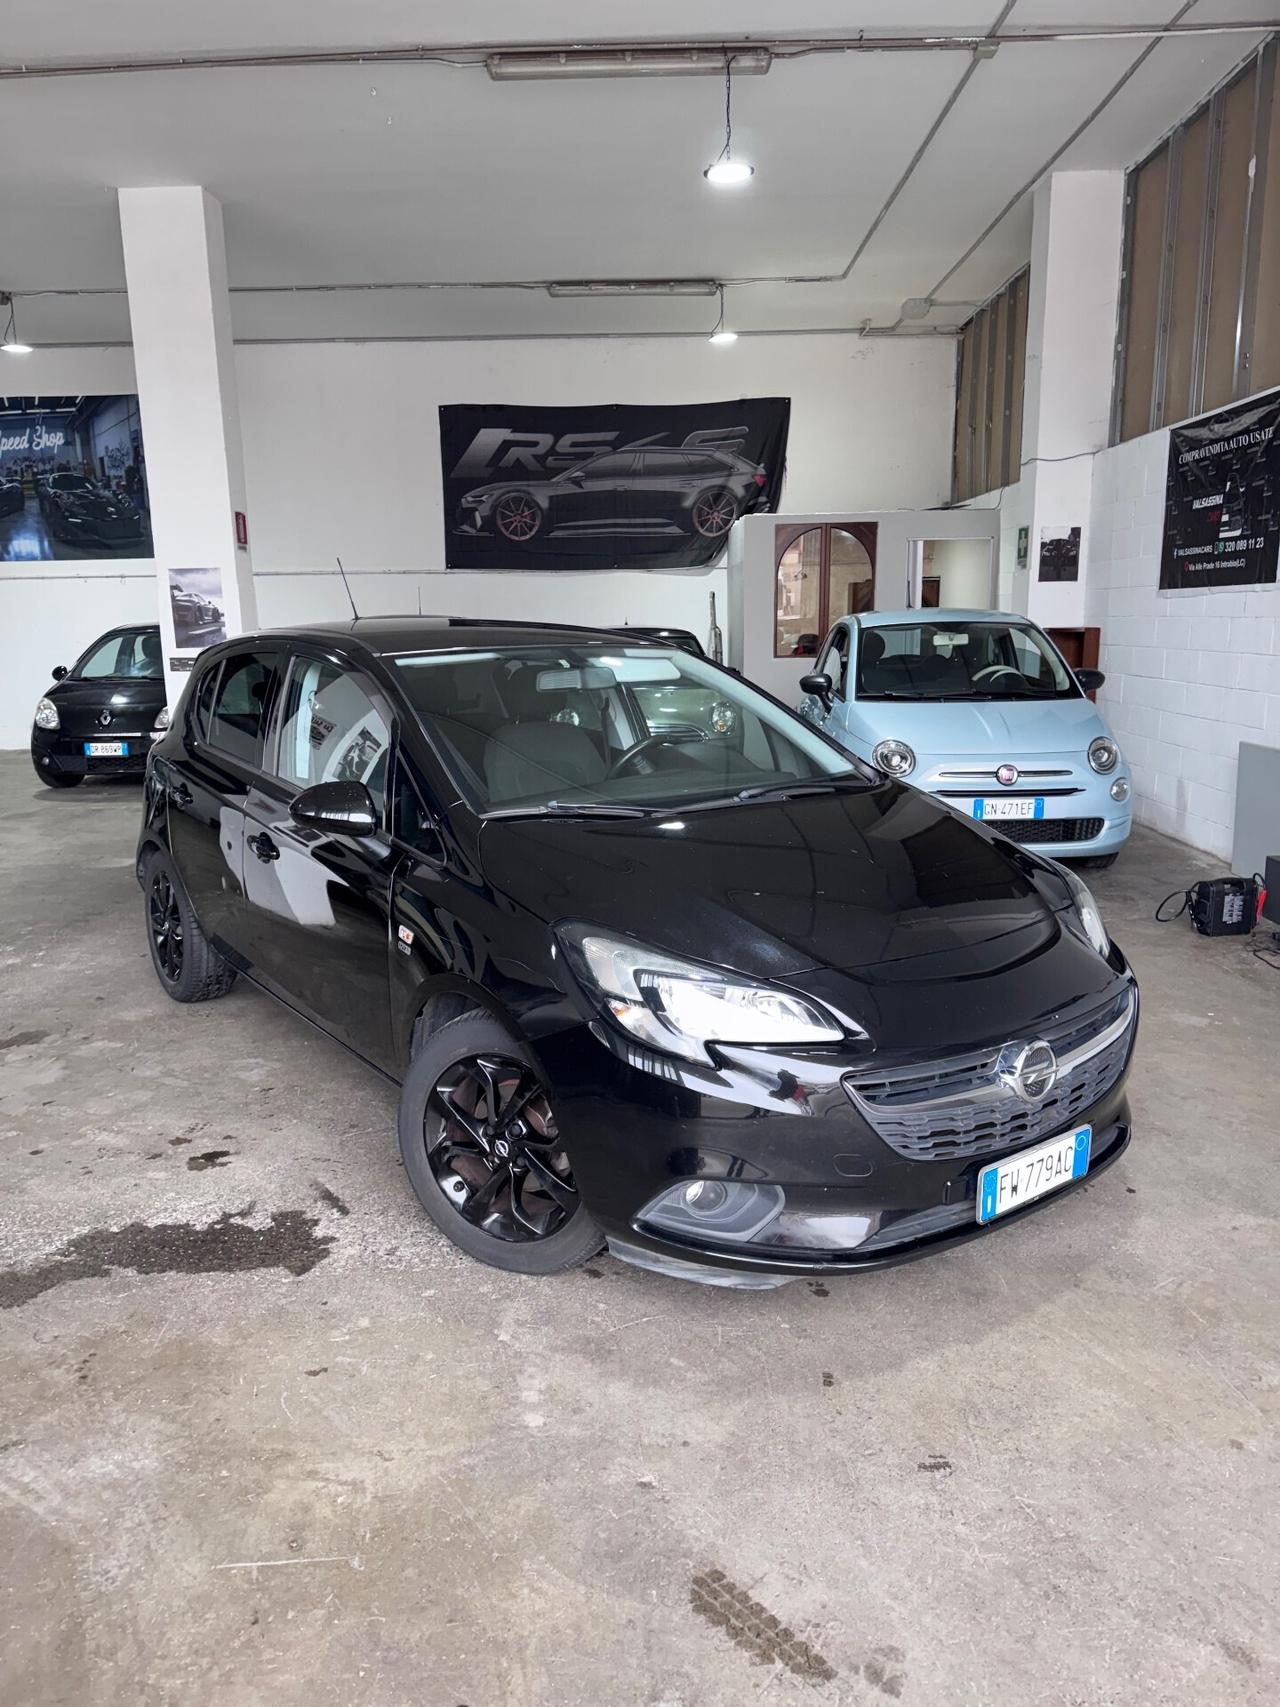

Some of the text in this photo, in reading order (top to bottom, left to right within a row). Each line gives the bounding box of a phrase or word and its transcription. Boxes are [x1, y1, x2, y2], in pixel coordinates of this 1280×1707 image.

[0, 425, 65, 460] peed Shop
[1178, 426, 1274, 465] COMPRAVENDITA AUTO USATE
[1192, 493, 1224, 509] VALSASSINA
[1225, 541, 1236, 552] 320
[1248, 538, 1255, 549] 11
[1256, 536, 1264, 548] 23
[1000, 802, 1033, 816] 471EF
[999, 1167, 1020, 1204] FW
[1025, 1146, 1074, 1193] 779AC
